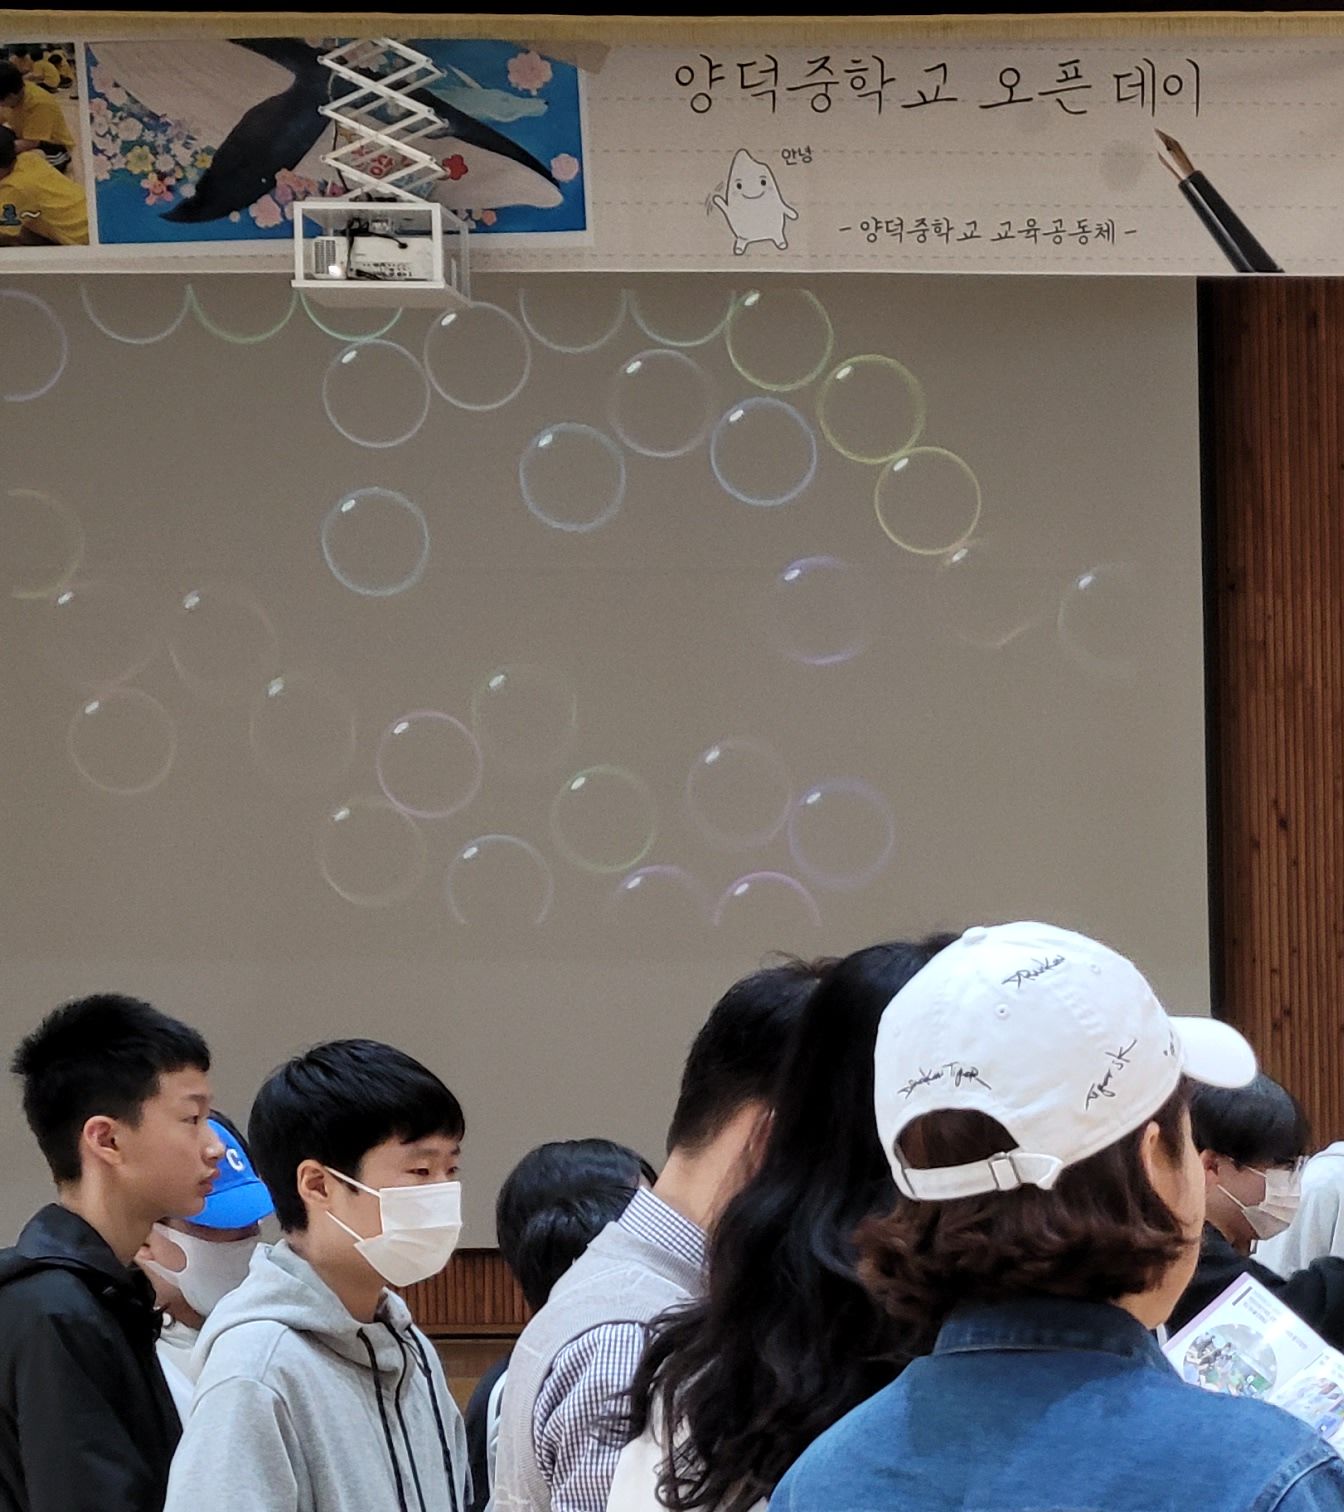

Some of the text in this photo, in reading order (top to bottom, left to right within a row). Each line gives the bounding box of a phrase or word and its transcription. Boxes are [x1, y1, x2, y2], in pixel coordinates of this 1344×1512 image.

[676, 53, 1202, 119] 양덕중학교 오픈 데이
[781, 146, 814, 166] 안녕
[859, 216, 982, 245] 양덕중학교
[990, 217, 1116, 246] 교육공동체
[226, 1148, 244, 1171] C
